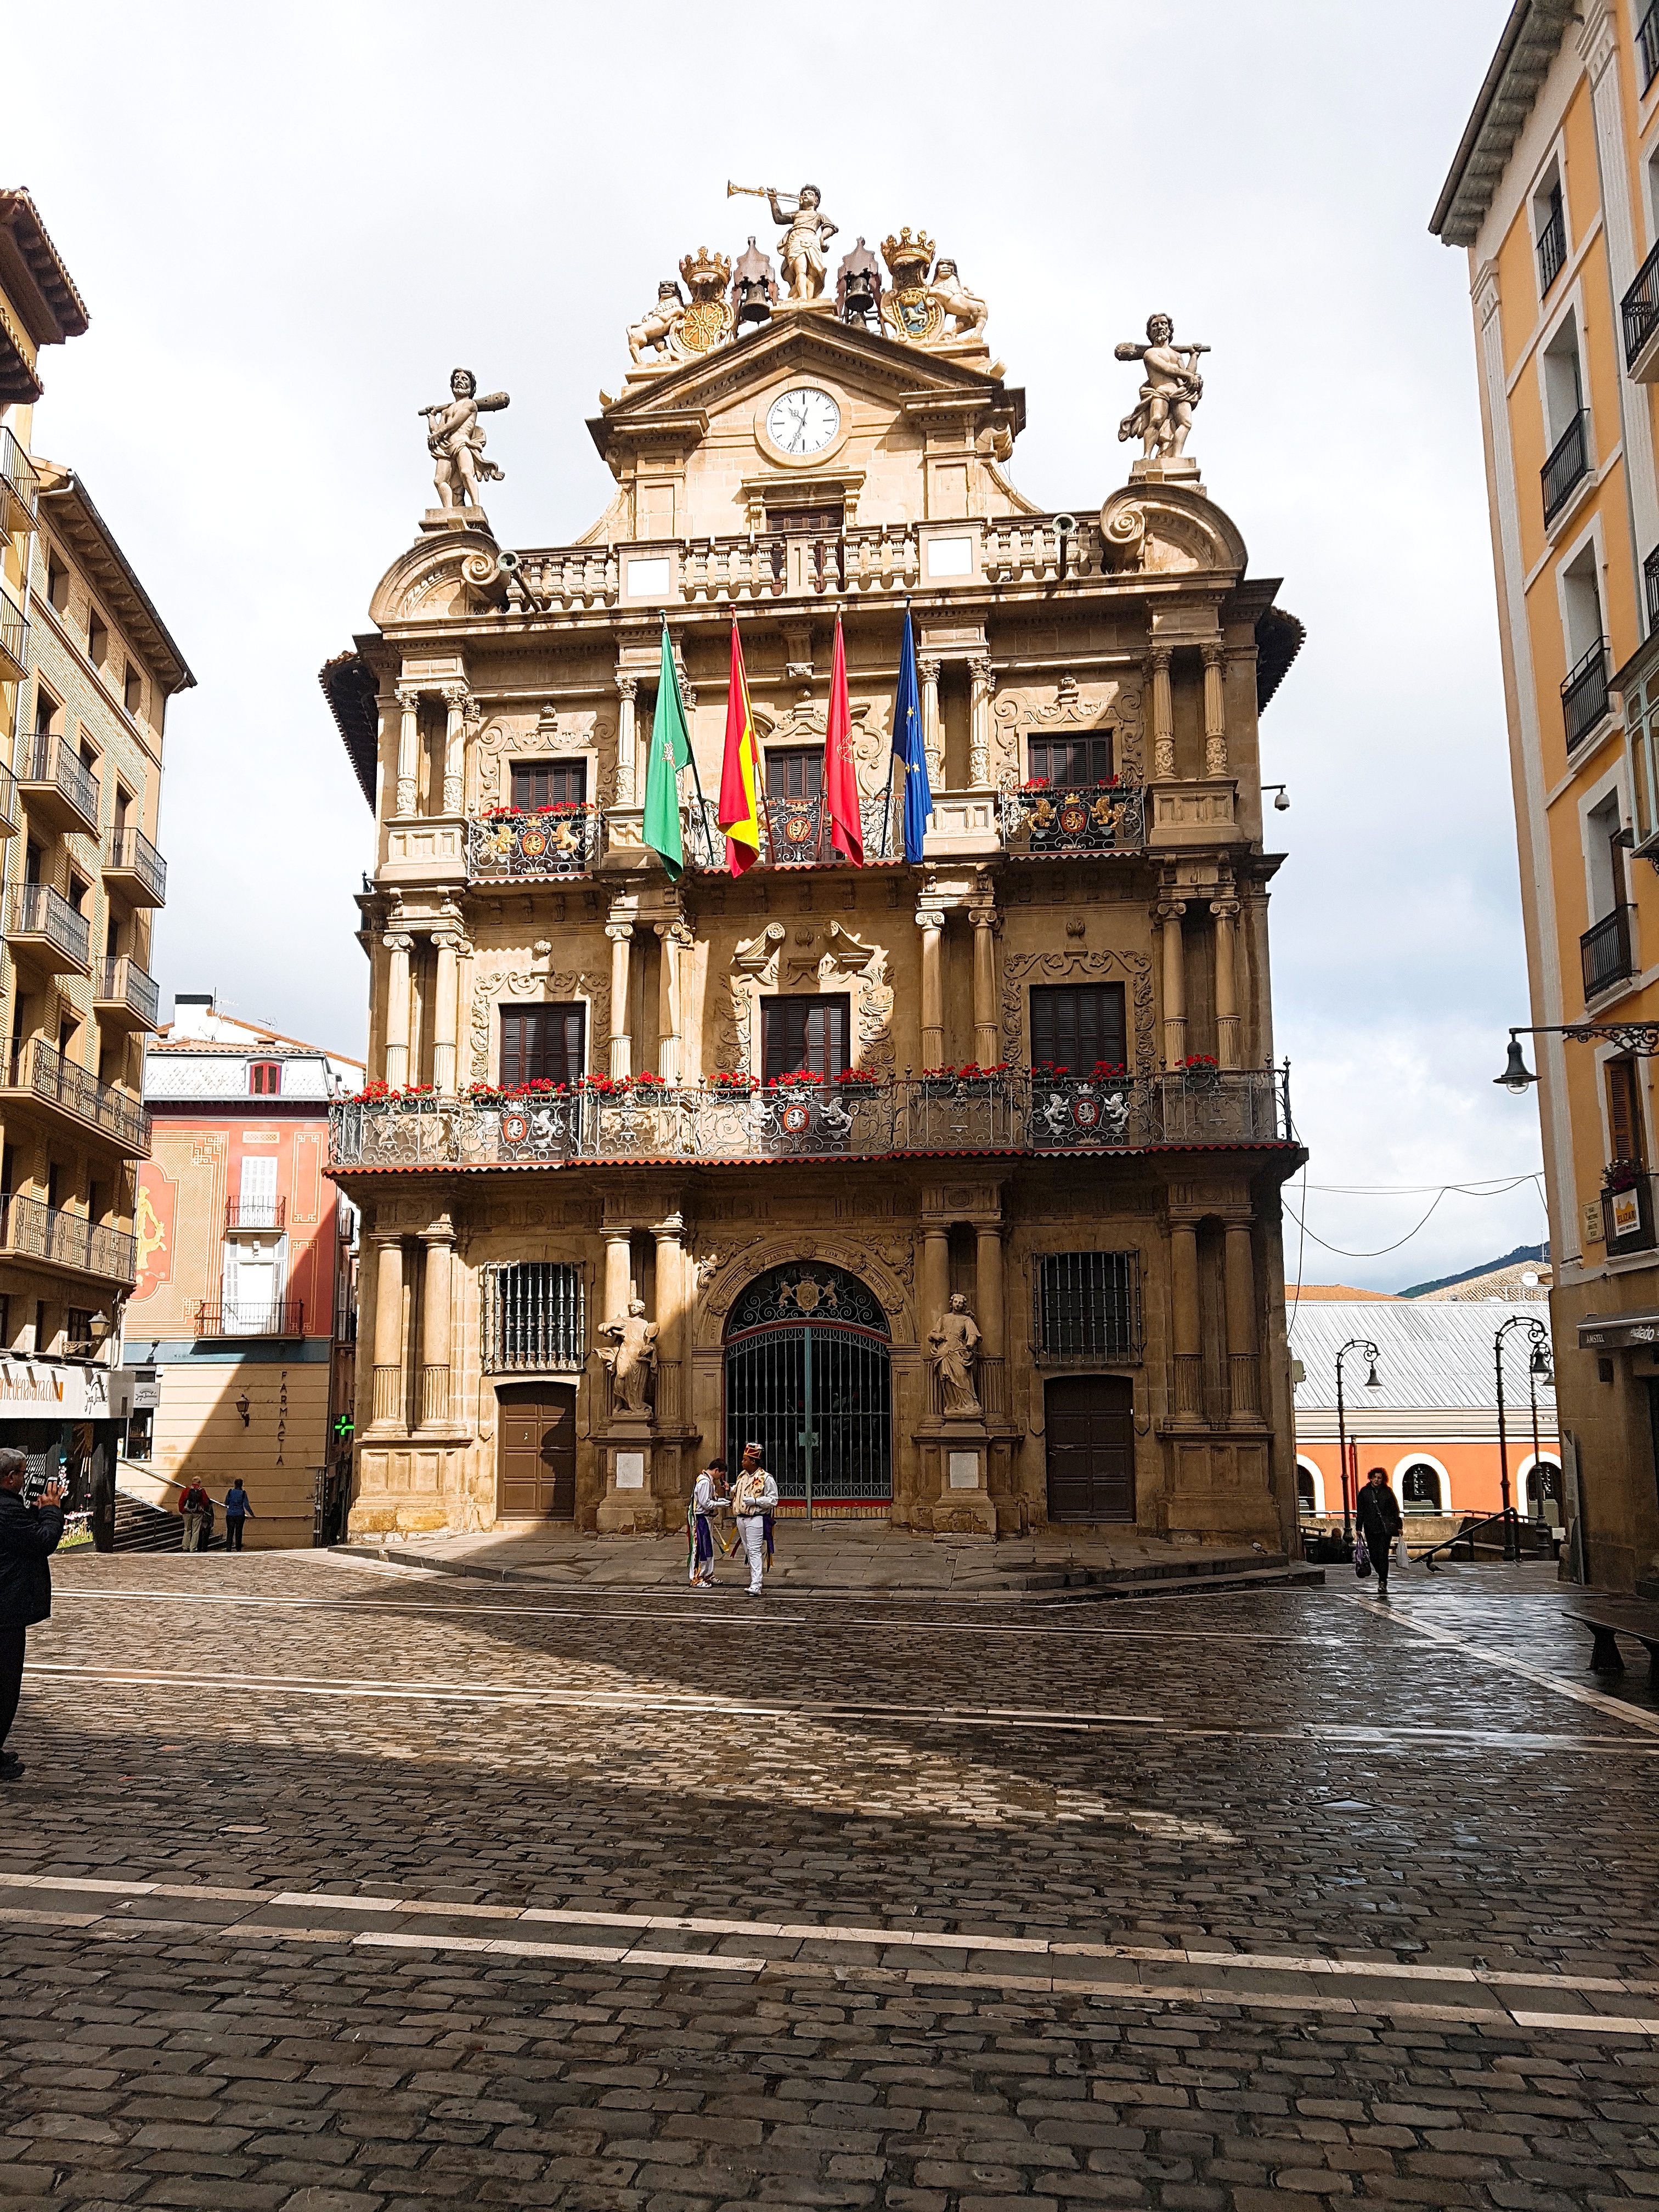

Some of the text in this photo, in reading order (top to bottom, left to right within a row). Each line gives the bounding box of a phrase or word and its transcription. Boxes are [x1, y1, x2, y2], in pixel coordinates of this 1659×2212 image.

[825, 1250, 838, 1258] COR
[1586, 1333, 1605, 1344] AMSTEL
[276, 1371, 288, 1465] FARMACIA
